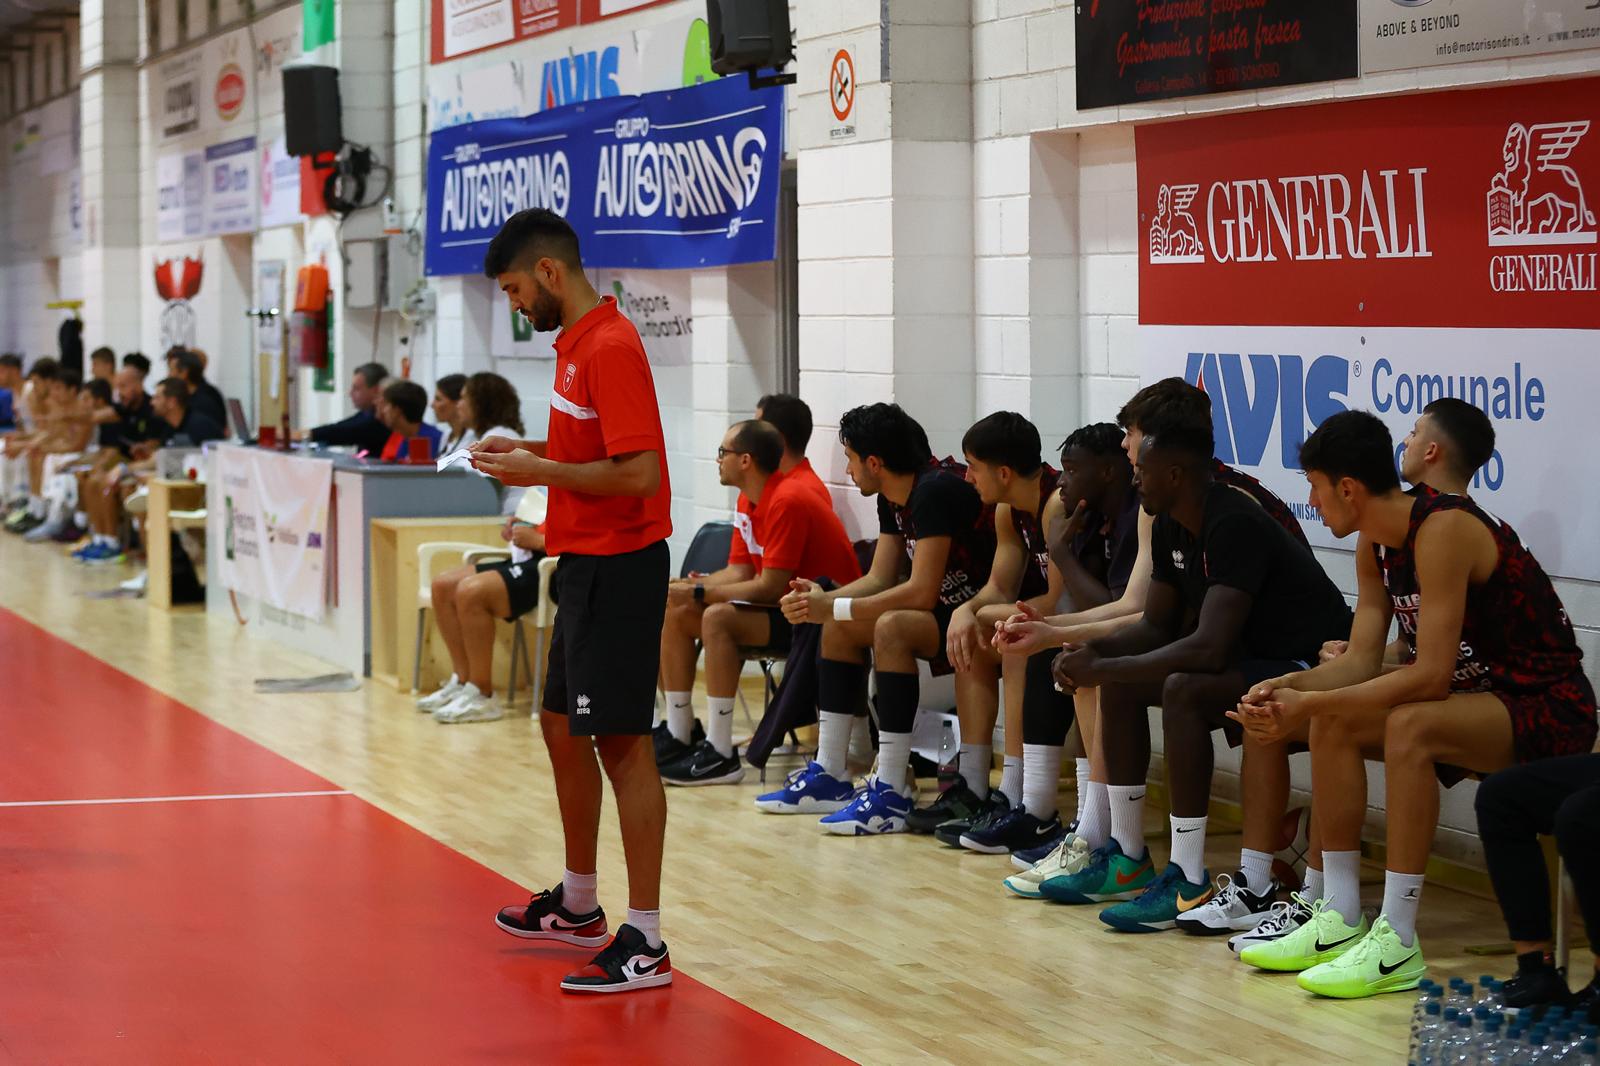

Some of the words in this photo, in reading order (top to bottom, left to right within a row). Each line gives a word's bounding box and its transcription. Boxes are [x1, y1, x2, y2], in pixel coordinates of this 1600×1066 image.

[1116, 31, 1192, 78] Gastronomia
[1208, 23, 1250, 61] pasta
[1254, 17, 1302, 59] fresca
[1376, 21, 1406, 38] ABOVE
[1410, 19, 1417, 33] &
[1421, 14, 1460, 32] BEYOND
[540, 46, 620, 111] AVIS
[614, 117, 649, 138] GRUPPO
[440, 150, 571, 233] AUTOTORINO
[594, 126, 767, 218] AUTOTORINO
[1207, 167, 1433, 263] GENERALI
[1489, 252, 1598, 292] GENERALI
[1184, 352, 1350, 470] AVIS
[1371, 357, 1546, 422] Comunale
[941, 570, 969, 592] etis
